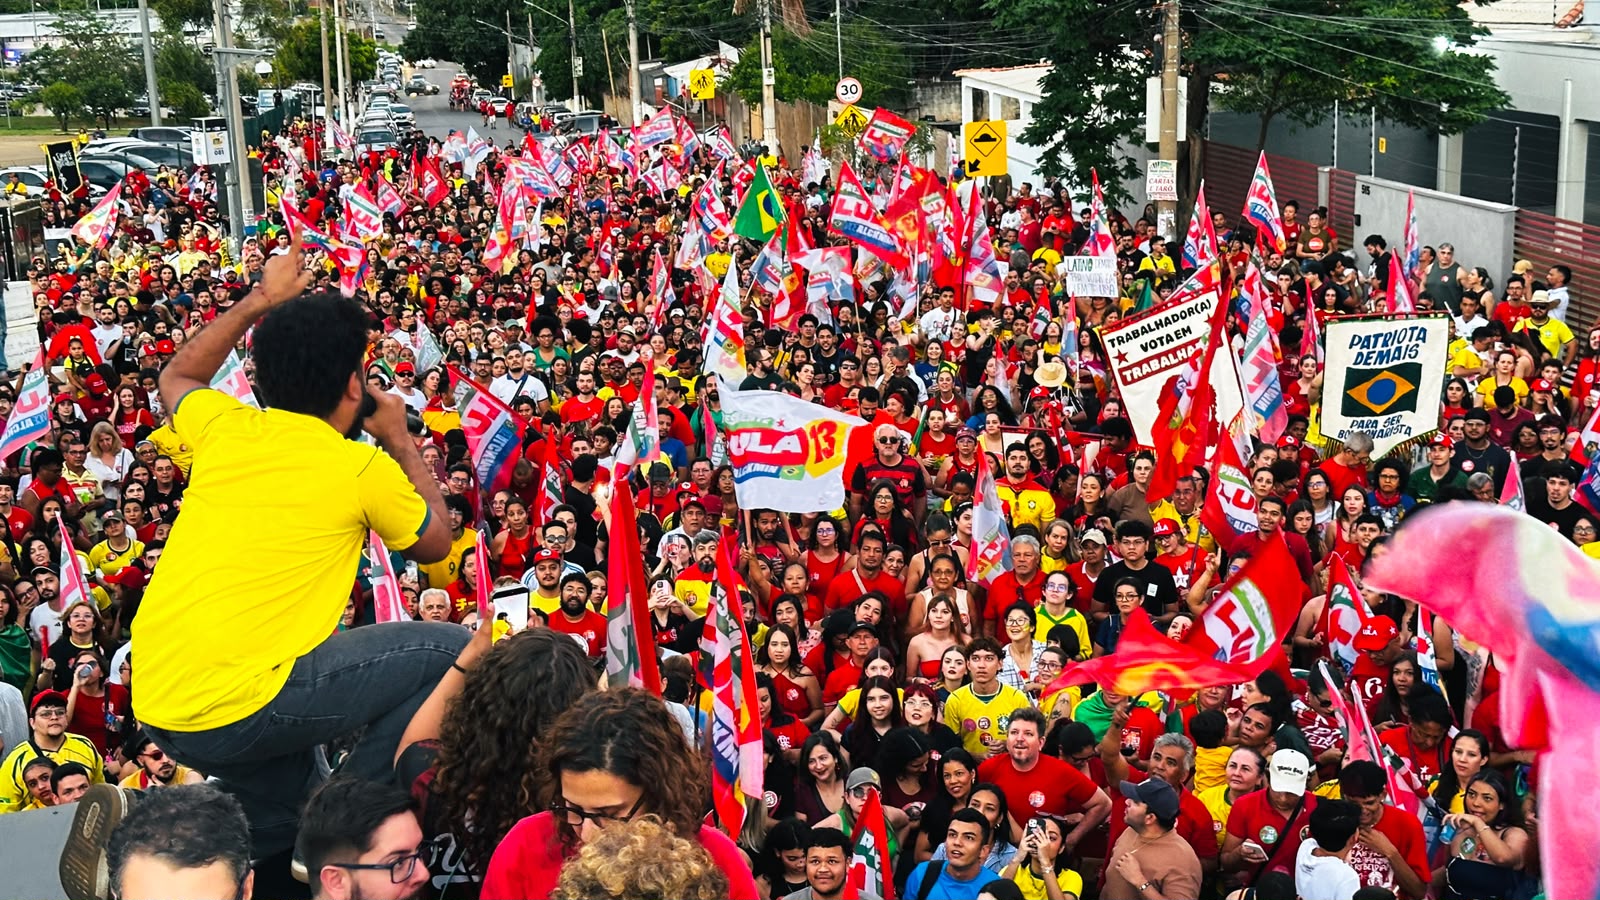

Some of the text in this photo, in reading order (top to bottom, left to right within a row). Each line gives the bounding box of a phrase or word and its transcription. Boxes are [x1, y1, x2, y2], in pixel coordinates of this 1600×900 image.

[841, 84, 858, 96] 30
[1067, 258, 1093, 272] LATINO
[1108, 298, 1212, 349] TRABALHADOR(A)
[1140, 325, 1193, 353] VOTA EM
[1348, 326, 1427, 349] PATRIOTA
[1122, 342, 1198, 382] TRABALHA
[1352, 343, 1419, 366] DEMAIS
[1337, 424, 1412, 440] BOONARISTA
[1350, 414, 1403, 429] PARA SER
[809, 420, 837, 464] 13
